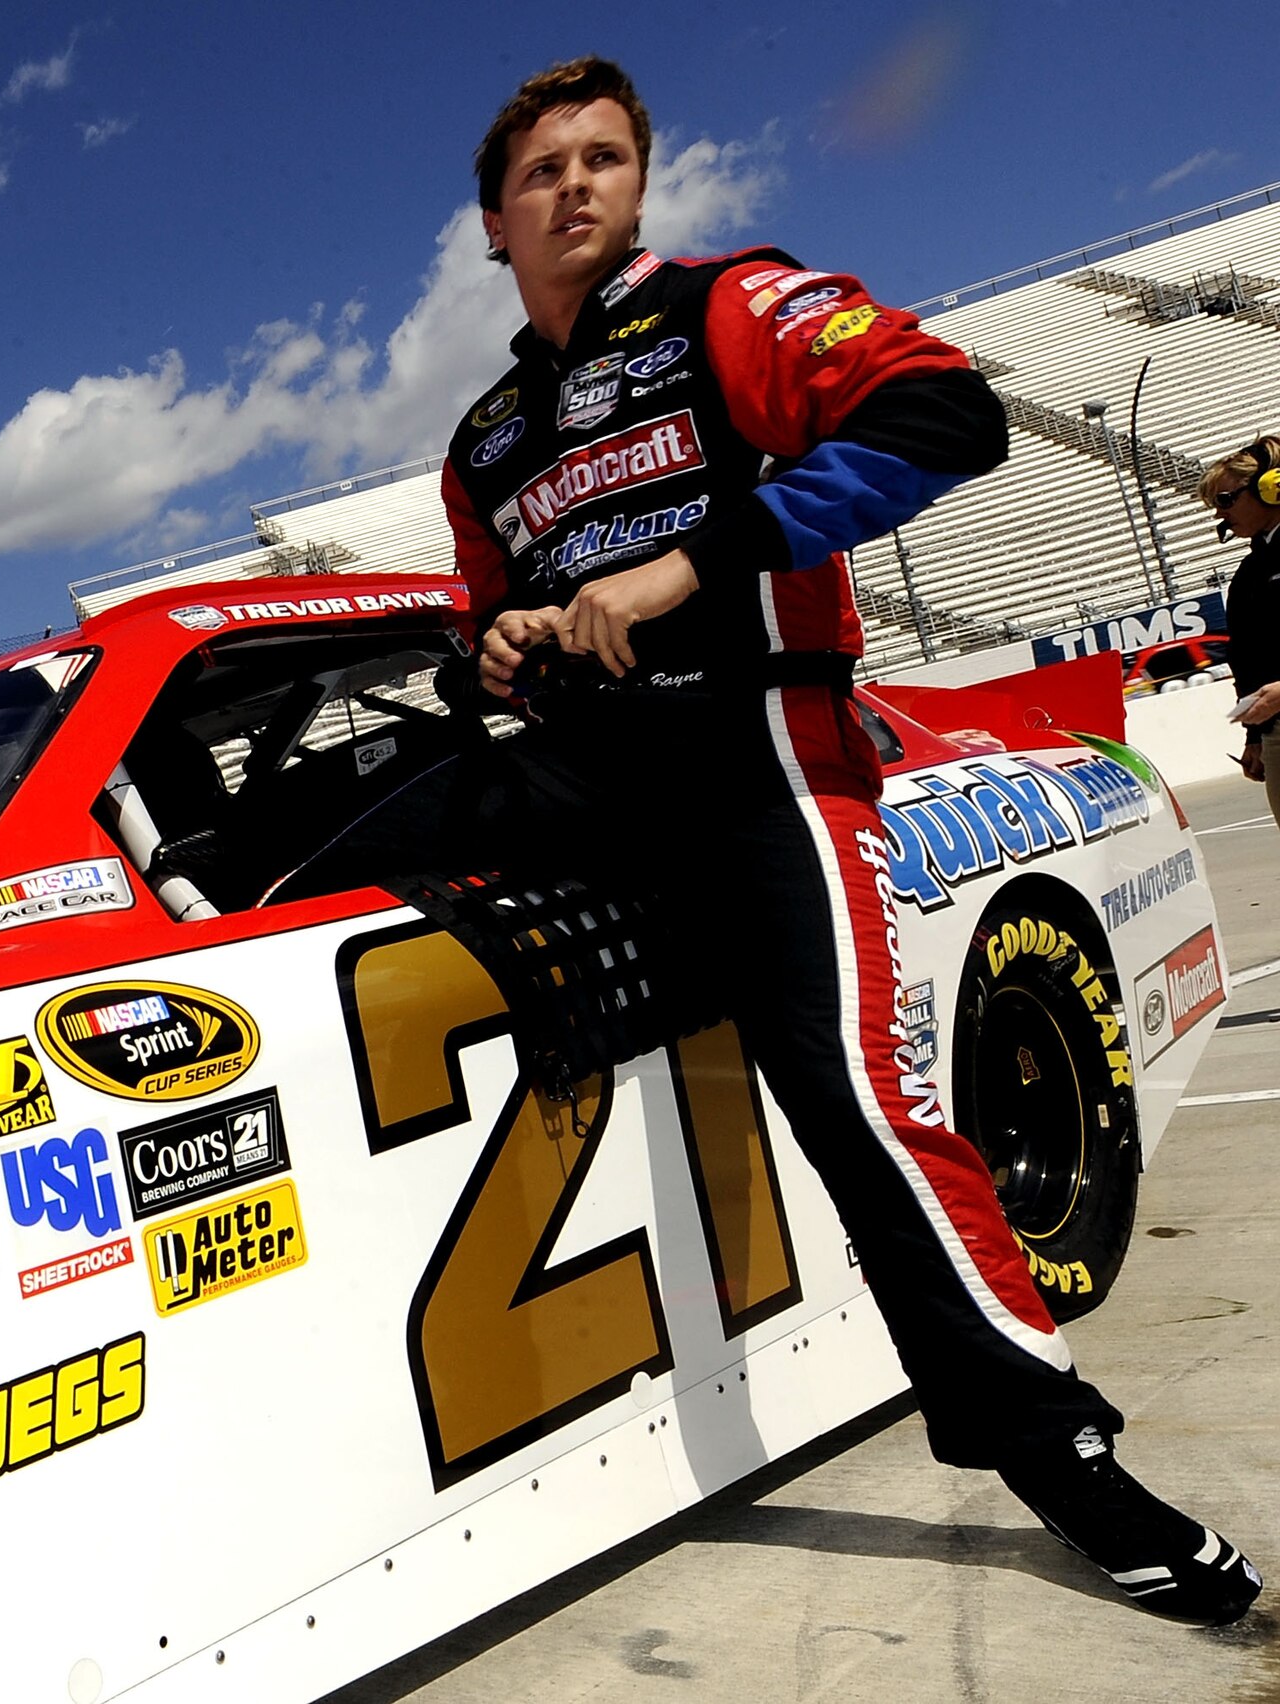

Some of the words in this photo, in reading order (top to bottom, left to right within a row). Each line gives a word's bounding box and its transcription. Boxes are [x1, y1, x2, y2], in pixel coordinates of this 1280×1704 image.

[568, 380, 619, 412] 500
[482, 424, 517, 461] Ford
[605, 501, 705, 549] Lane
[223, 597, 351, 621] TREVOR
[353, 590, 453, 613] BAYNE
[1053, 601, 1206, 661] TUMS
[21, 867, 97, 898] NASCAR
[61, 892, 117, 907] CAR
[1101, 883, 1130, 933] TIRE
[1137, 864, 1164, 911] AUTO
[1163, 848, 1196, 896] CENTER
[1169, 946, 1220, 1022] Motorcraft
[96, 995, 162, 1033] NASCAR
[906, 1003, 931, 1028] HALL
[120, 1021, 193, 1067] Sprint
[914, 1042, 934, 1065] AME
[144, 1074, 181, 1095] CUP
[185, 1056, 243, 1084] SERIES
[233, 1109, 268, 1153] 21
[132, 1130, 228, 1184] Coors
[236, 1151, 260, 1165] MEANS
[0, 1128, 122, 1238] USG
[141, 1179, 185, 1204] BREWING
[186, 1165, 230, 1189] COMPANY
[193, 1200, 272, 1253] Auto
[335, 918, 803, 1494] 21
[22, 1244, 128, 1294] SHEETROCK
[190, 1226, 294, 1298] Meter
[203, 1267, 262, 1296] PERFORMANCE
[264, 1255, 297, 1274] GAUGES
